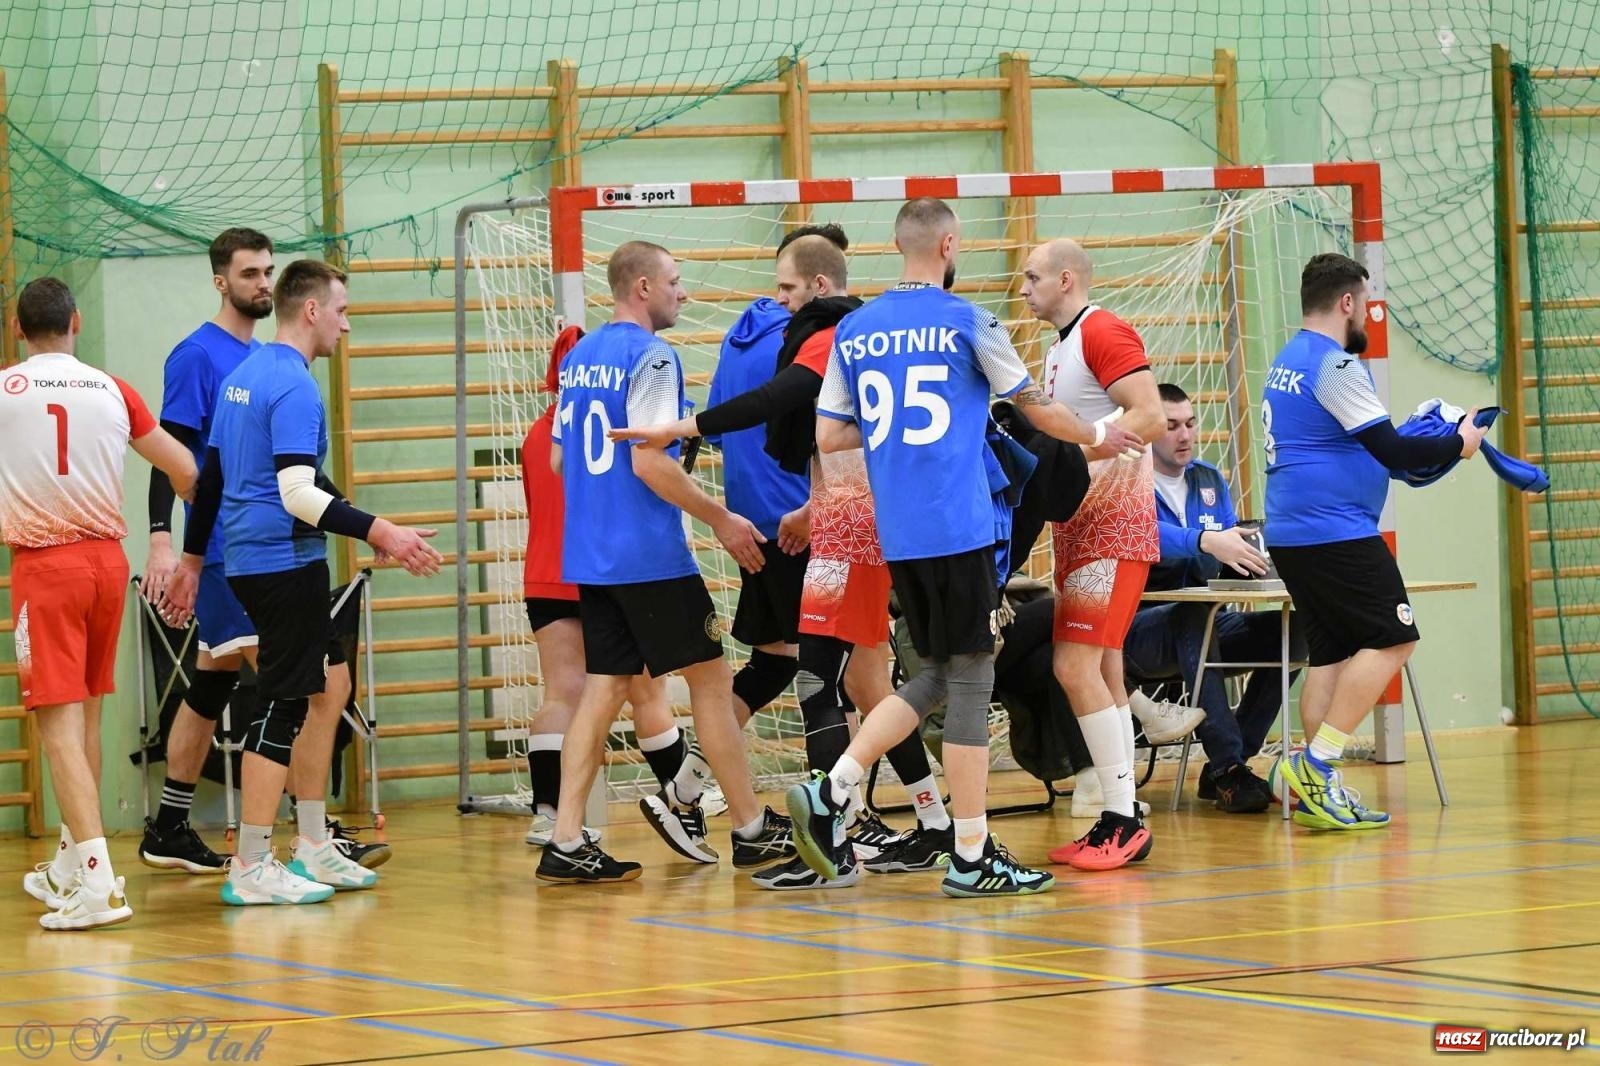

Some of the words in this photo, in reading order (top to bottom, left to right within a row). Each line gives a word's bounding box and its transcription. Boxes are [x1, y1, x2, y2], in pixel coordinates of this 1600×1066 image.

[641, 189, 675, 203] sport
[839, 326, 960, 366] PSOTNIK
[33, 379, 68, 388] TOKAI
[69, 379, 108, 391] COBEX
[857, 364, 951, 452] 95
[47, 403, 69, 476] 1
[560, 400, 616, 476] 10
[916, 790, 935, 805] R
